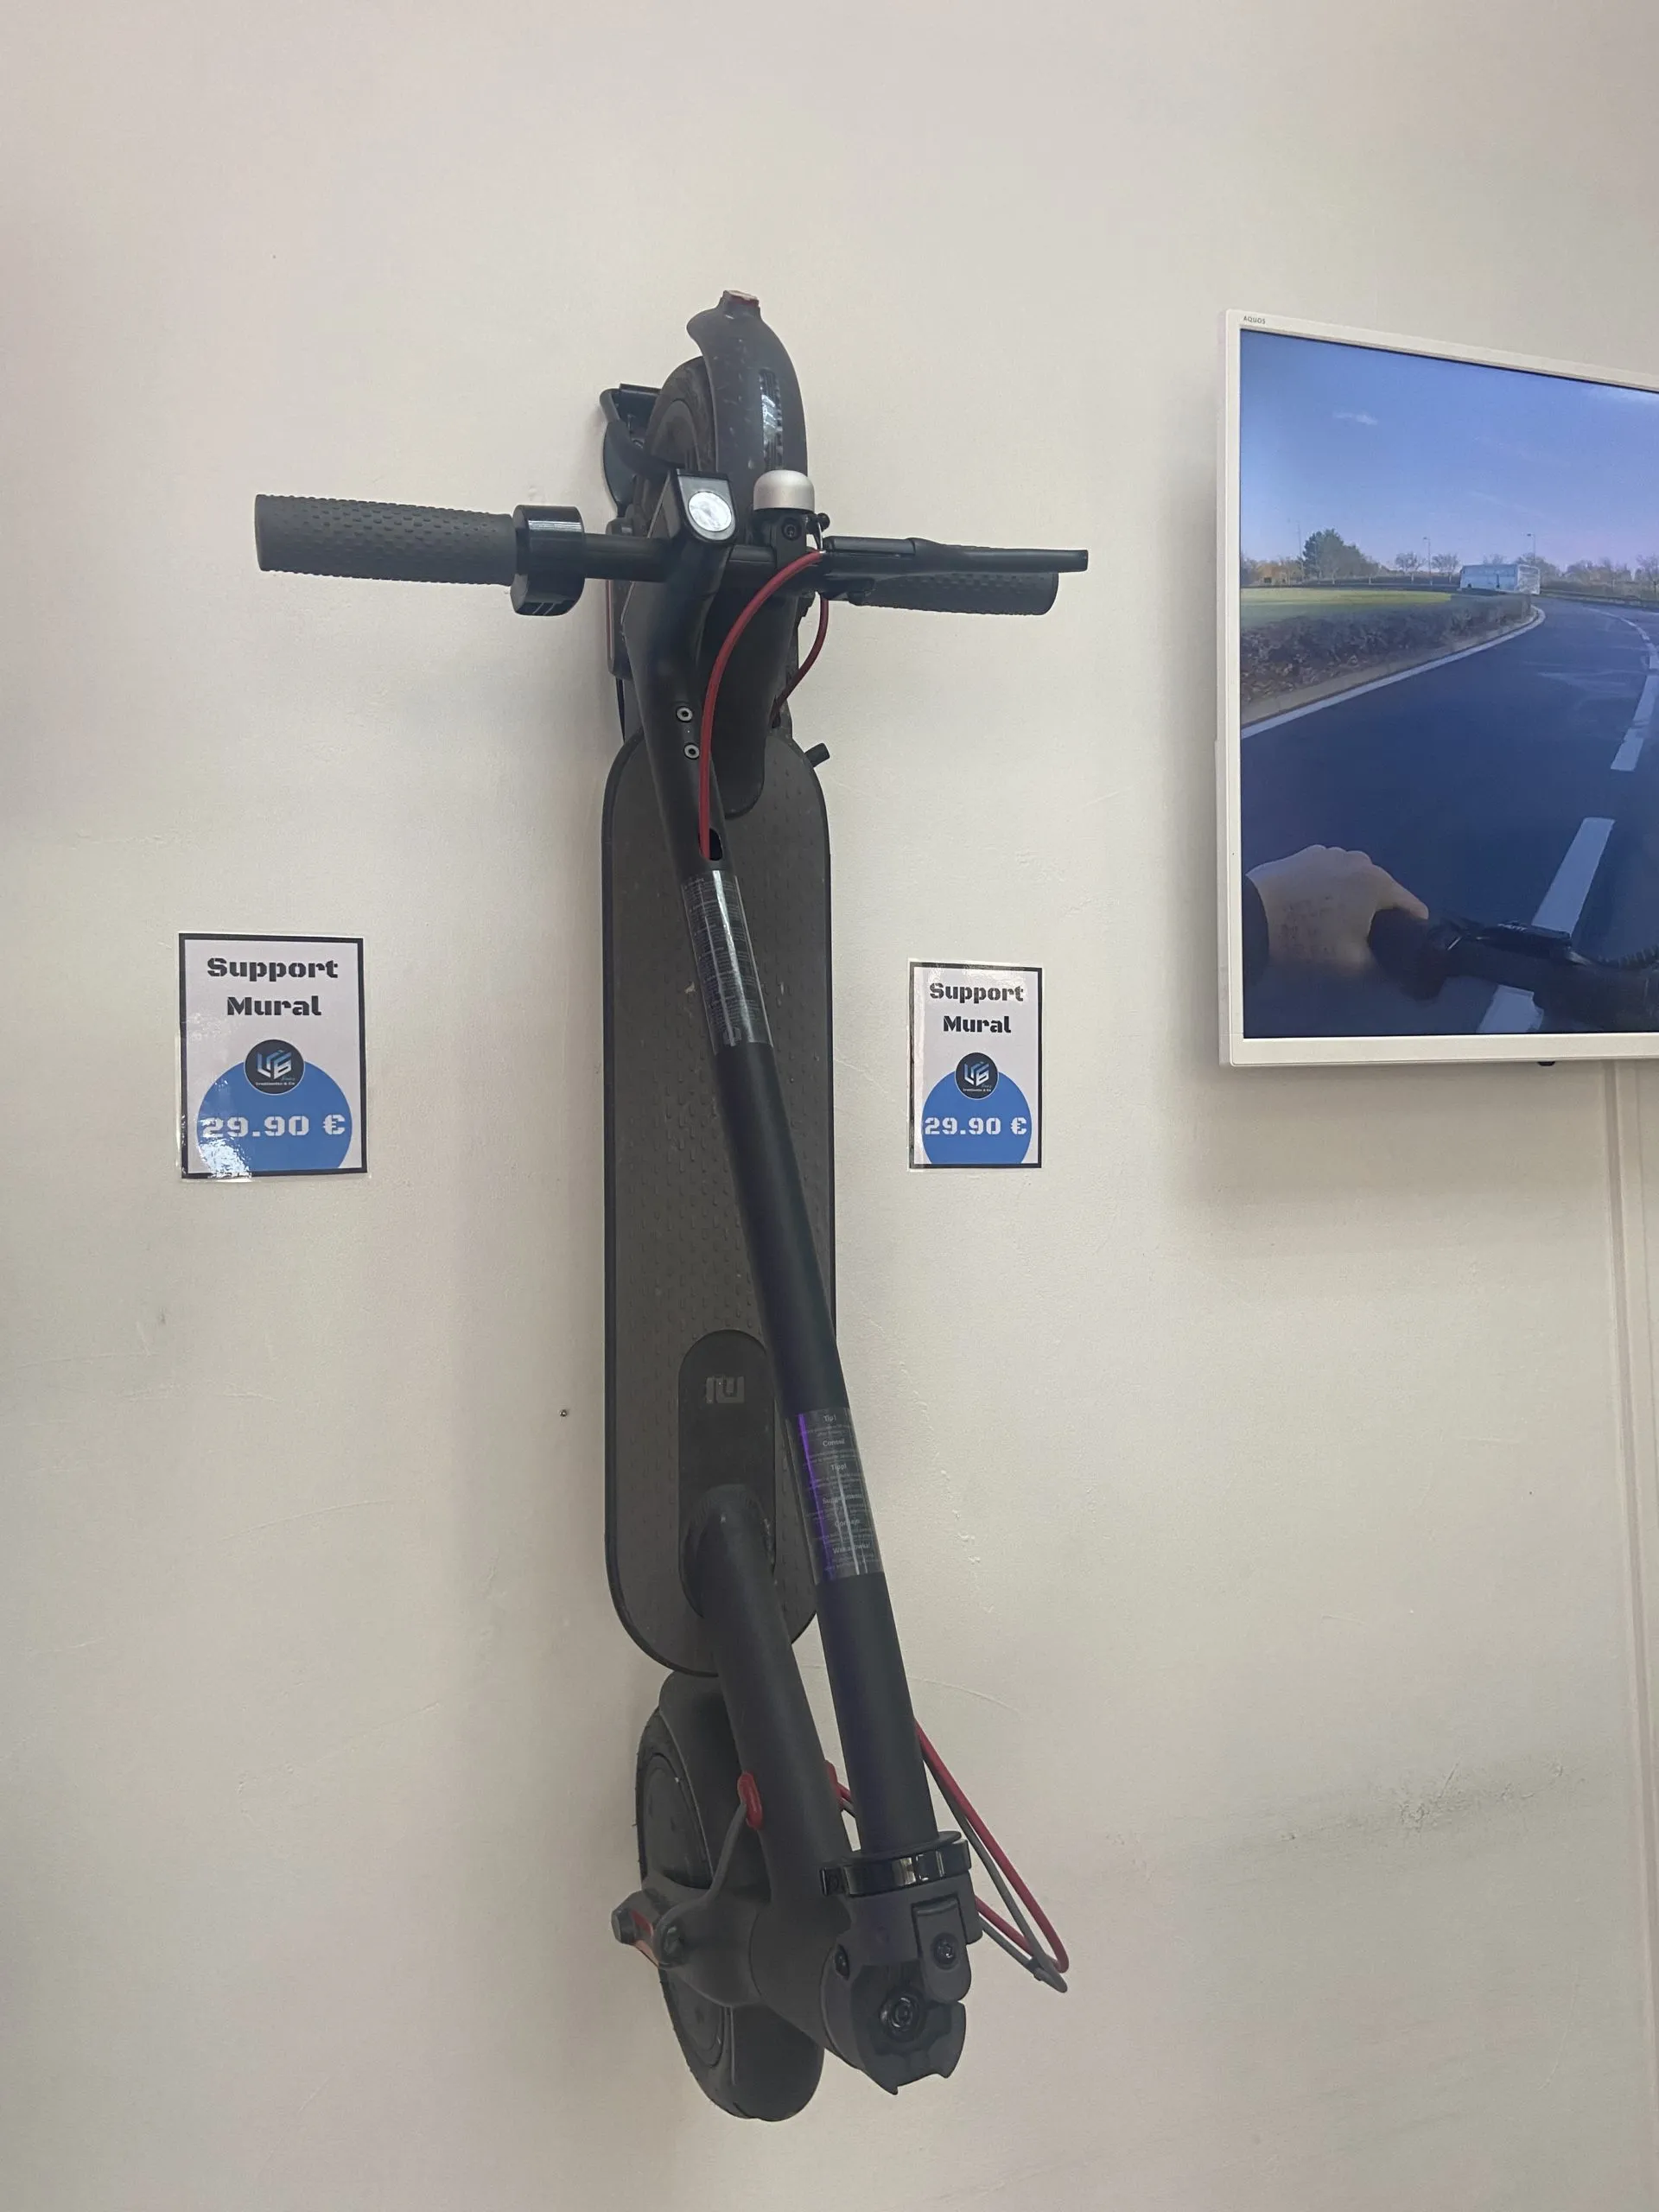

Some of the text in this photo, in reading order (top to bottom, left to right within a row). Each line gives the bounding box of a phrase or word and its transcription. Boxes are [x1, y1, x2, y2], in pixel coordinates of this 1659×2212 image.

[1243, 315, 1266, 324] AQUOS
[207, 957, 339, 982] Support
[929, 982, 1024, 1004] Support
[226, 995, 321, 1016] Mural
[944, 1015, 1011, 1033] Mural
[201, 1114, 346, 1139] 29.90 €
[925, 1116, 1027, 1136] 29.90 €
